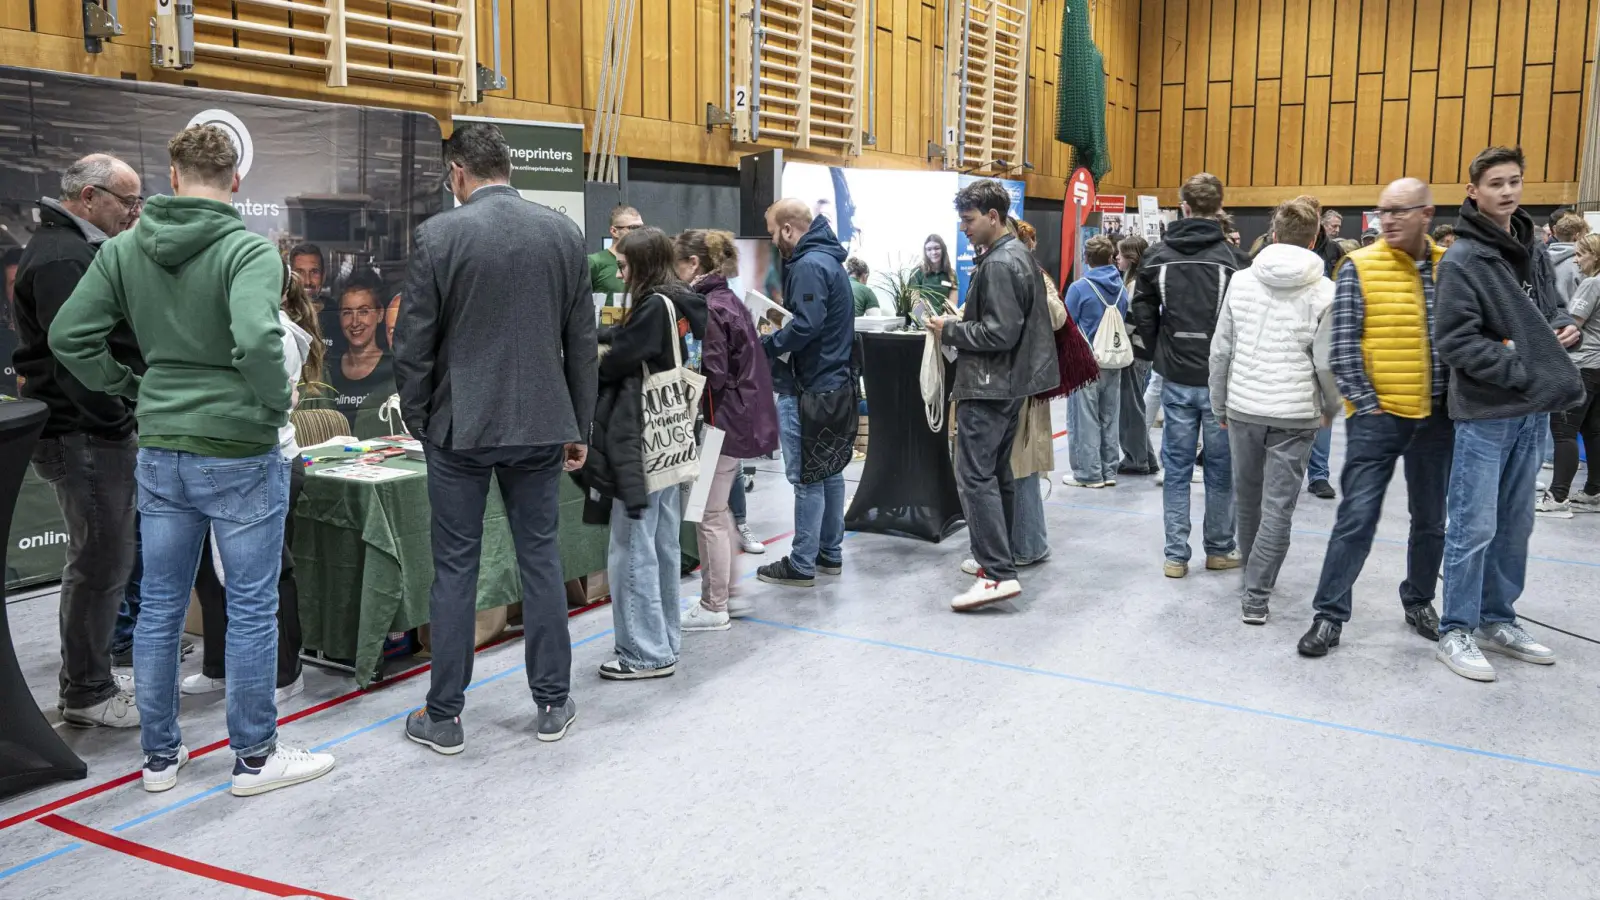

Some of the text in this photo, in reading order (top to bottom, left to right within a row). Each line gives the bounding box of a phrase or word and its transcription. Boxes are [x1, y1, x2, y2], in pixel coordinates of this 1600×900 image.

[737, 90, 745, 107] 2
[948, 129, 953, 142] 1
[229, 198, 280, 217] nters
[18, 530, 70, 550] onlin
